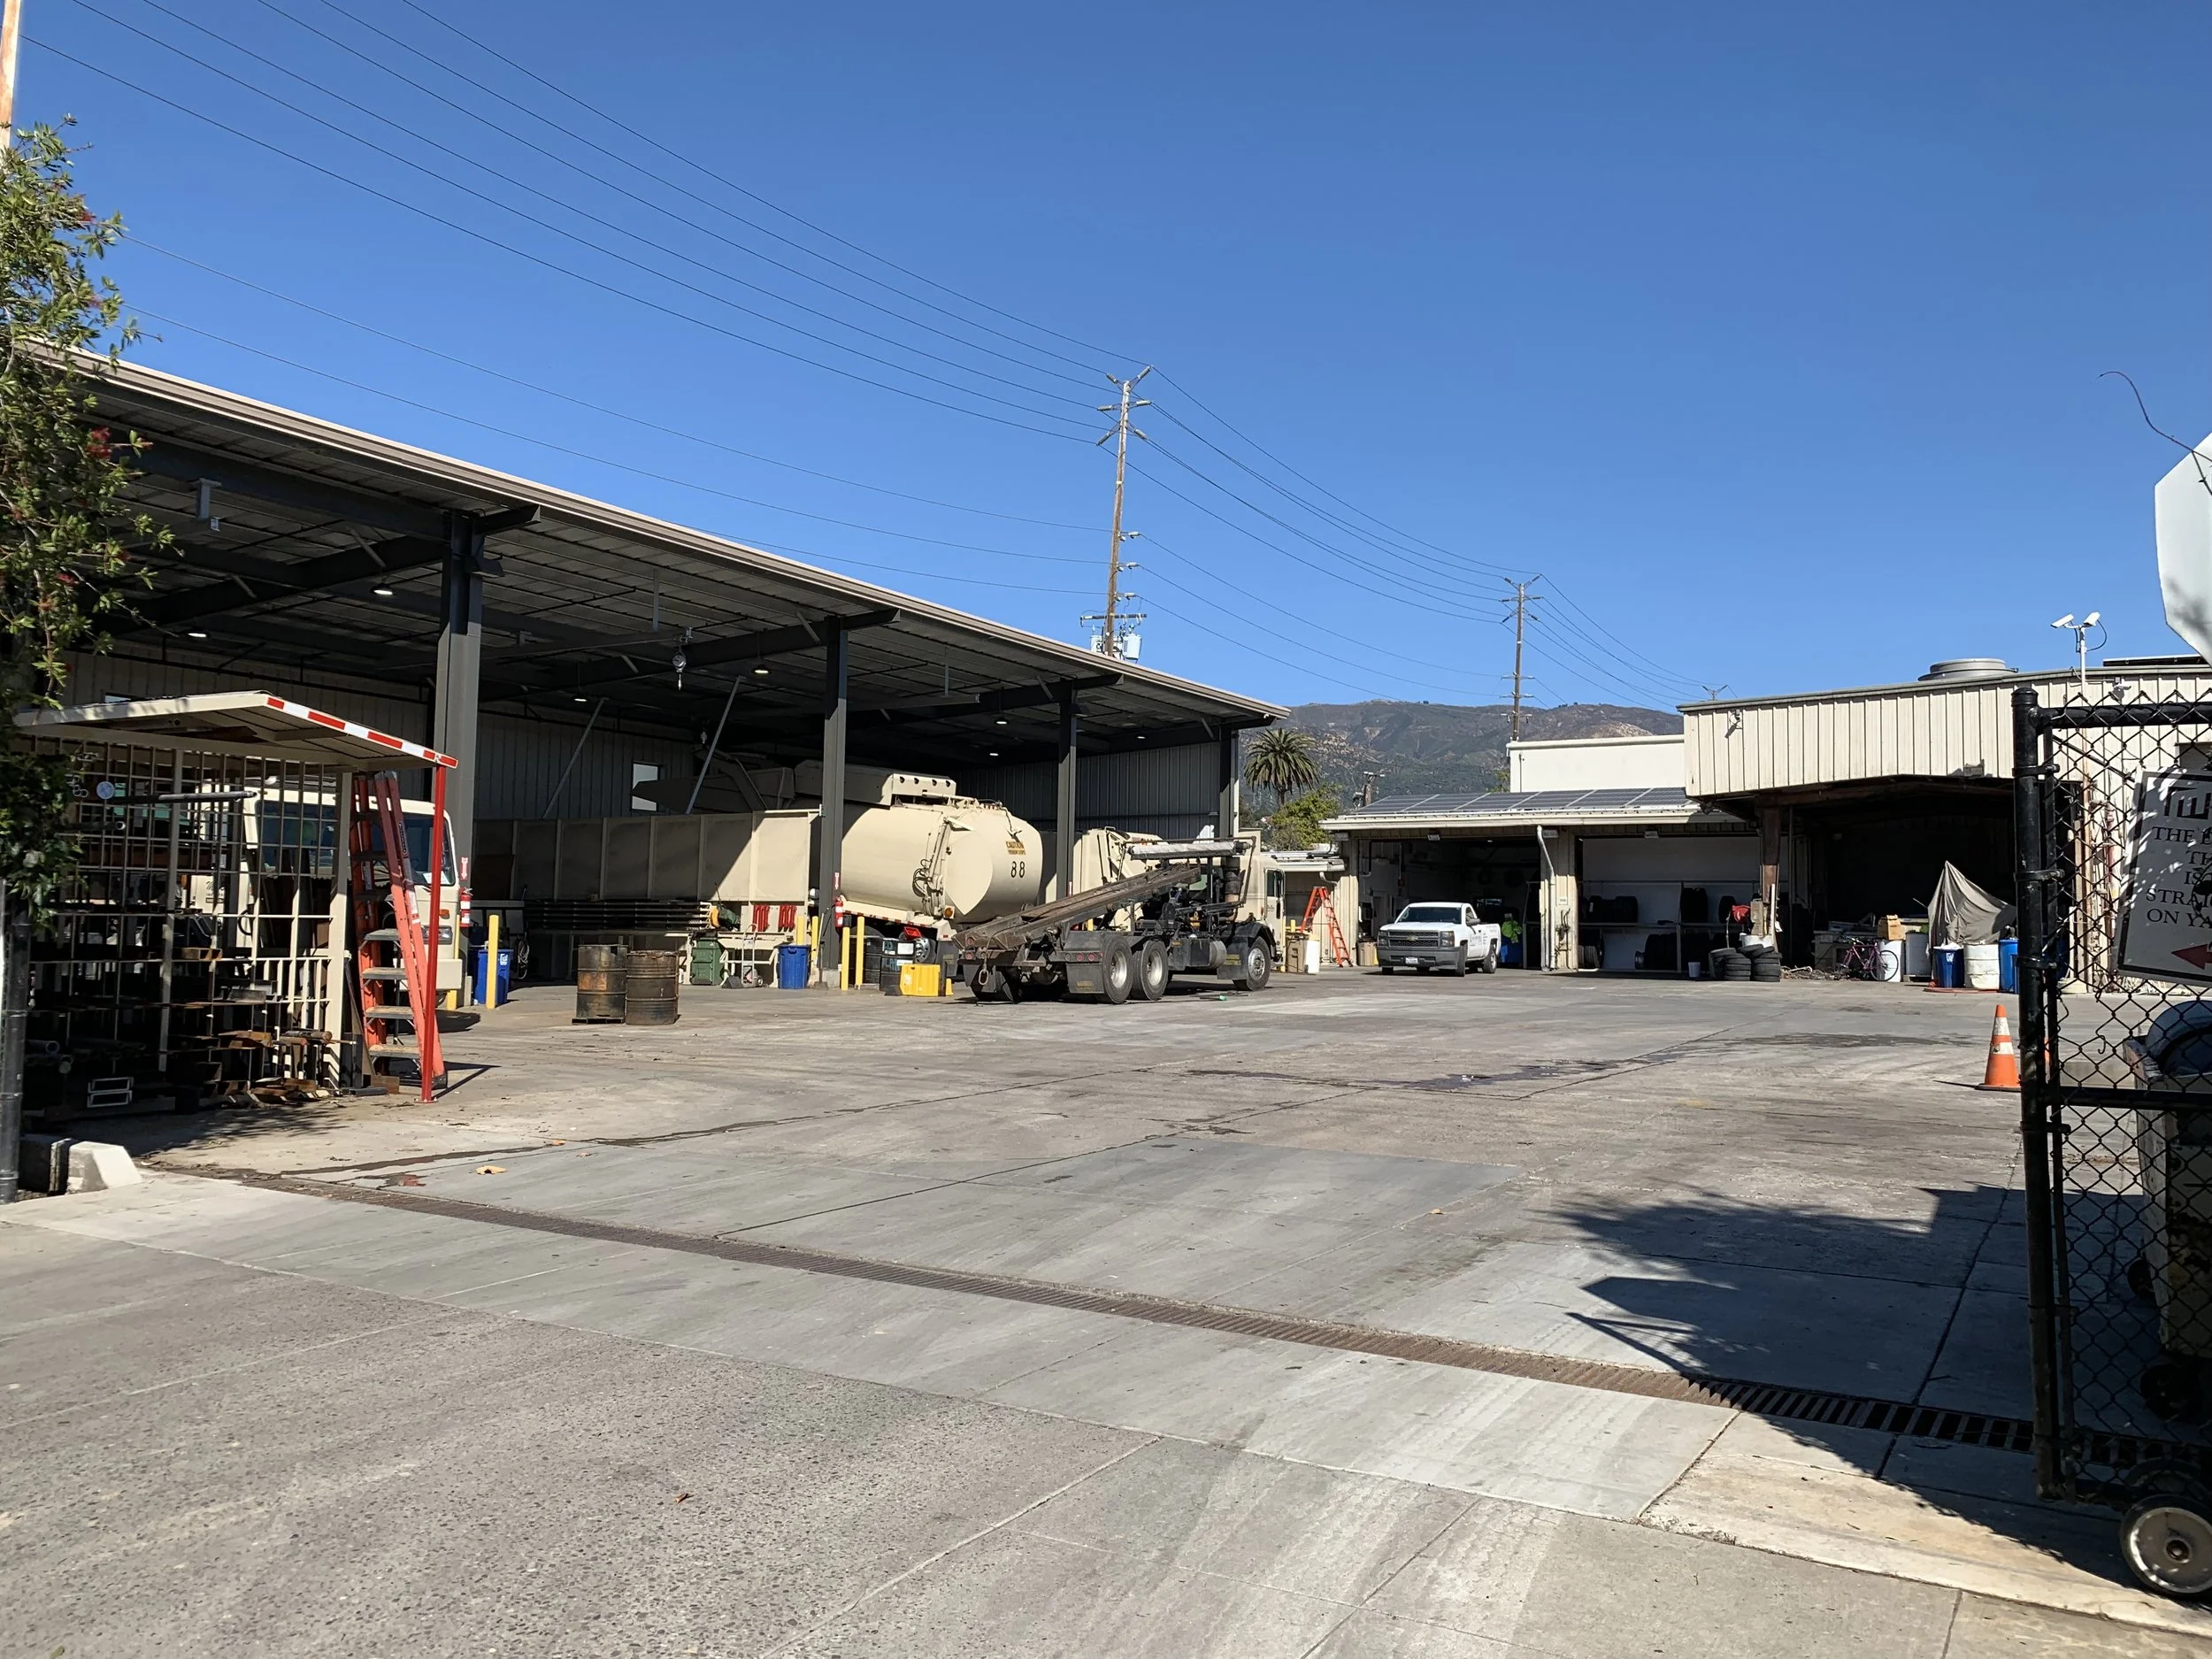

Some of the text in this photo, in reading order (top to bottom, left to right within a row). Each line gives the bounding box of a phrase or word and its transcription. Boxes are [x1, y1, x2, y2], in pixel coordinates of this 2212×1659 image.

[2152, 826, 2194, 843] THE
[1010, 861, 1025, 878] 88
[2146, 888, 2212, 908] STRAI
[2147, 908, 2179, 924] ON
